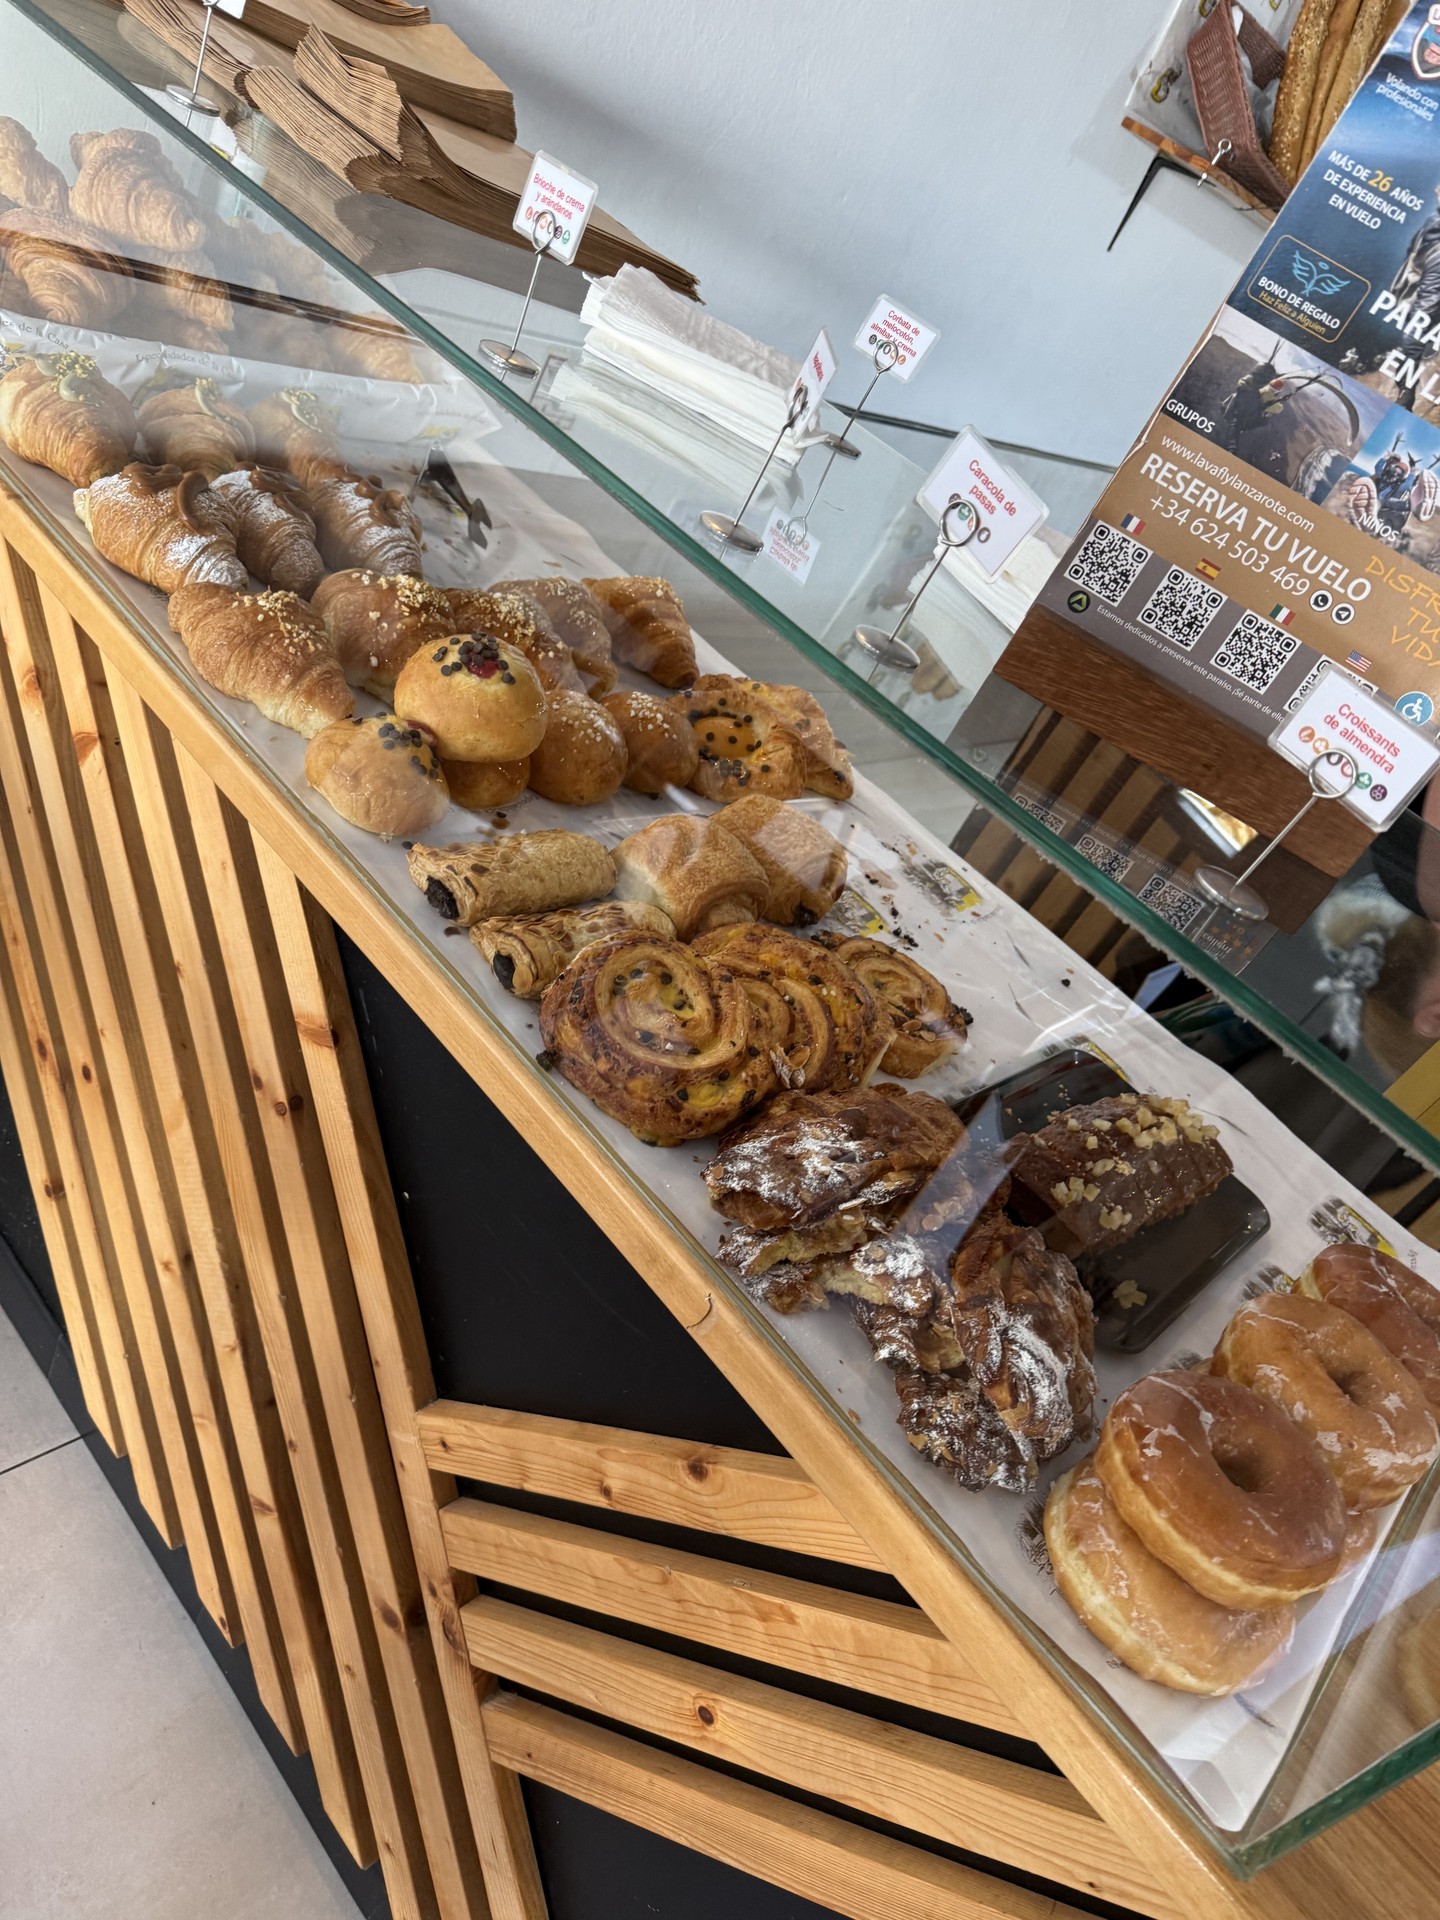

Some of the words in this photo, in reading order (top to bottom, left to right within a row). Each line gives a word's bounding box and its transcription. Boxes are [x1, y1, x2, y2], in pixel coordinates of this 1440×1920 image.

[1375, 82, 1435, 122] profesionales
[1386, 72, 1422, 101] Volando
[1421, 95, 1439, 111] con
[533, 173, 556, 195] Brioche
[556, 188, 565, 201] de
[565, 195, 586, 213] crema
[535, 191, 542, 202] y
[1323, 169, 1342, 186] DE
[1338, 178, 1407, 224] EXPERIENCIA
[1328, 150, 1355, 172] MÁS
[1352, 164, 1372, 182] DE
[1367, 170, 1394, 192] 26
[1389, 186, 1425, 211] AÑOS
[1328, 193, 1347, 211] EN
[1345, 202, 1381, 230] VUELO
[888, 310, 912, 331] Corbata
[911, 326, 921, 337] de
[1257, 276, 1289, 299] BONO
[1286, 293, 1304, 308] DE
[1300, 301, 1341, 329] REGALO
[1258, 290, 1273, 305] Haz
[1273, 298, 1292, 315] Feliz
[1290, 310, 1297, 318] a
[1296, 312, 1327, 335] Alguien
[896, 341, 917, 358] crema
[1378, 348, 1427, 390] EN
[1165, 398, 1216, 434] GRUPOS
[968, 485, 997, 515] pasas
[969, 459, 1005, 504] Caracola
[1004, 501, 1017, 517] de
[1160, 435, 1315, 533] www.lavaflylanzarote.com
[1139, 452, 1249, 533] RESERVA
[1250, 515, 1290, 552] TU
[1287, 537, 1372, 601] VUELO
[1150, 495, 1191, 526] +34
[1189, 517, 1231, 550] 624
[1228, 540, 1270, 573] 503
[1269, 565, 1311, 596] 469
[1358, 512, 1400, 543] NIÑOS
[1096, 604, 1125, 626] Estamos
[1123, 622, 1159, 646] dedicados
[1160, 645, 1193, 667] preservar
[1192, 663, 1208, 677] este
[1242, 694, 1263, 709] parte
[1261, 705, 1272, 716] de
[1391, 625, 1440, 666] VID
[1323, 714, 1340, 730] de
[1339, 728, 1395, 775] almendra
[1338, 703, 1401, 758] Croissants
